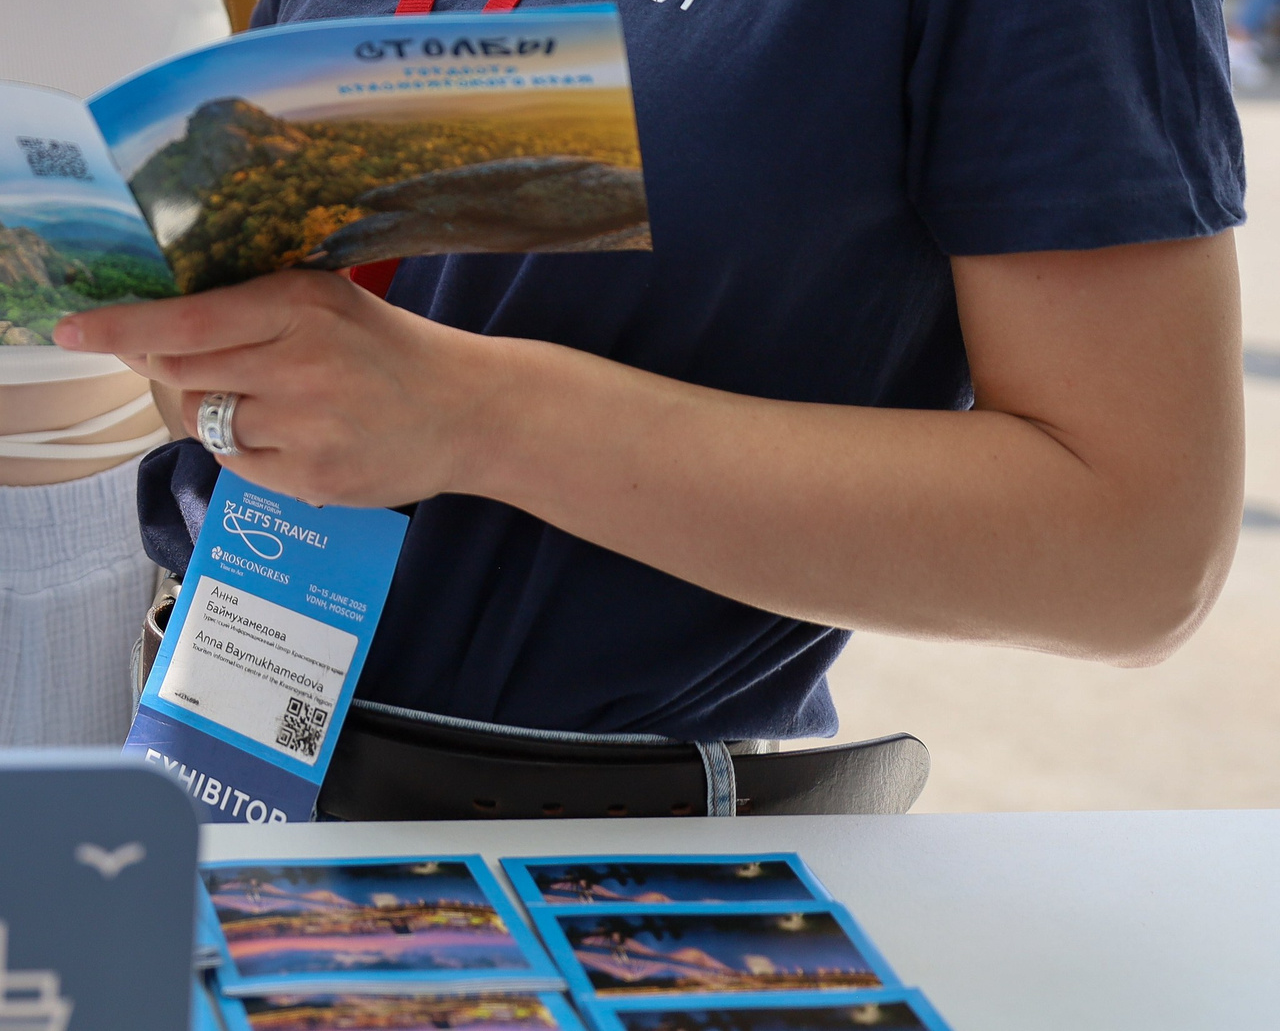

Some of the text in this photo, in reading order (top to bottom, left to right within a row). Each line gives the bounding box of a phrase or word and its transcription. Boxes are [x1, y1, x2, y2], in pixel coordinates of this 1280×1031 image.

[242, 497, 282, 516] TOURISM FORUM
[243, 492, 280, 509] INTERNATIONAL
[237, 505, 328, 549] LET'S TRAVEL!
[222, 551, 290, 585] ROSCONGRESS
[210, 585, 239, 606] Анна
[305, 593, 364, 622] VDNH, MOSCOW
[329, 592, 348, 606] JUNE
[349, 599, 367, 613] 2025
[206, 600, 287, 642] Баймухамедова
[192, 643, 212, 657] Tourism
[213, 652, 244, 670] information
[195, 630, 324, 693] Anna Baymukhamedova
